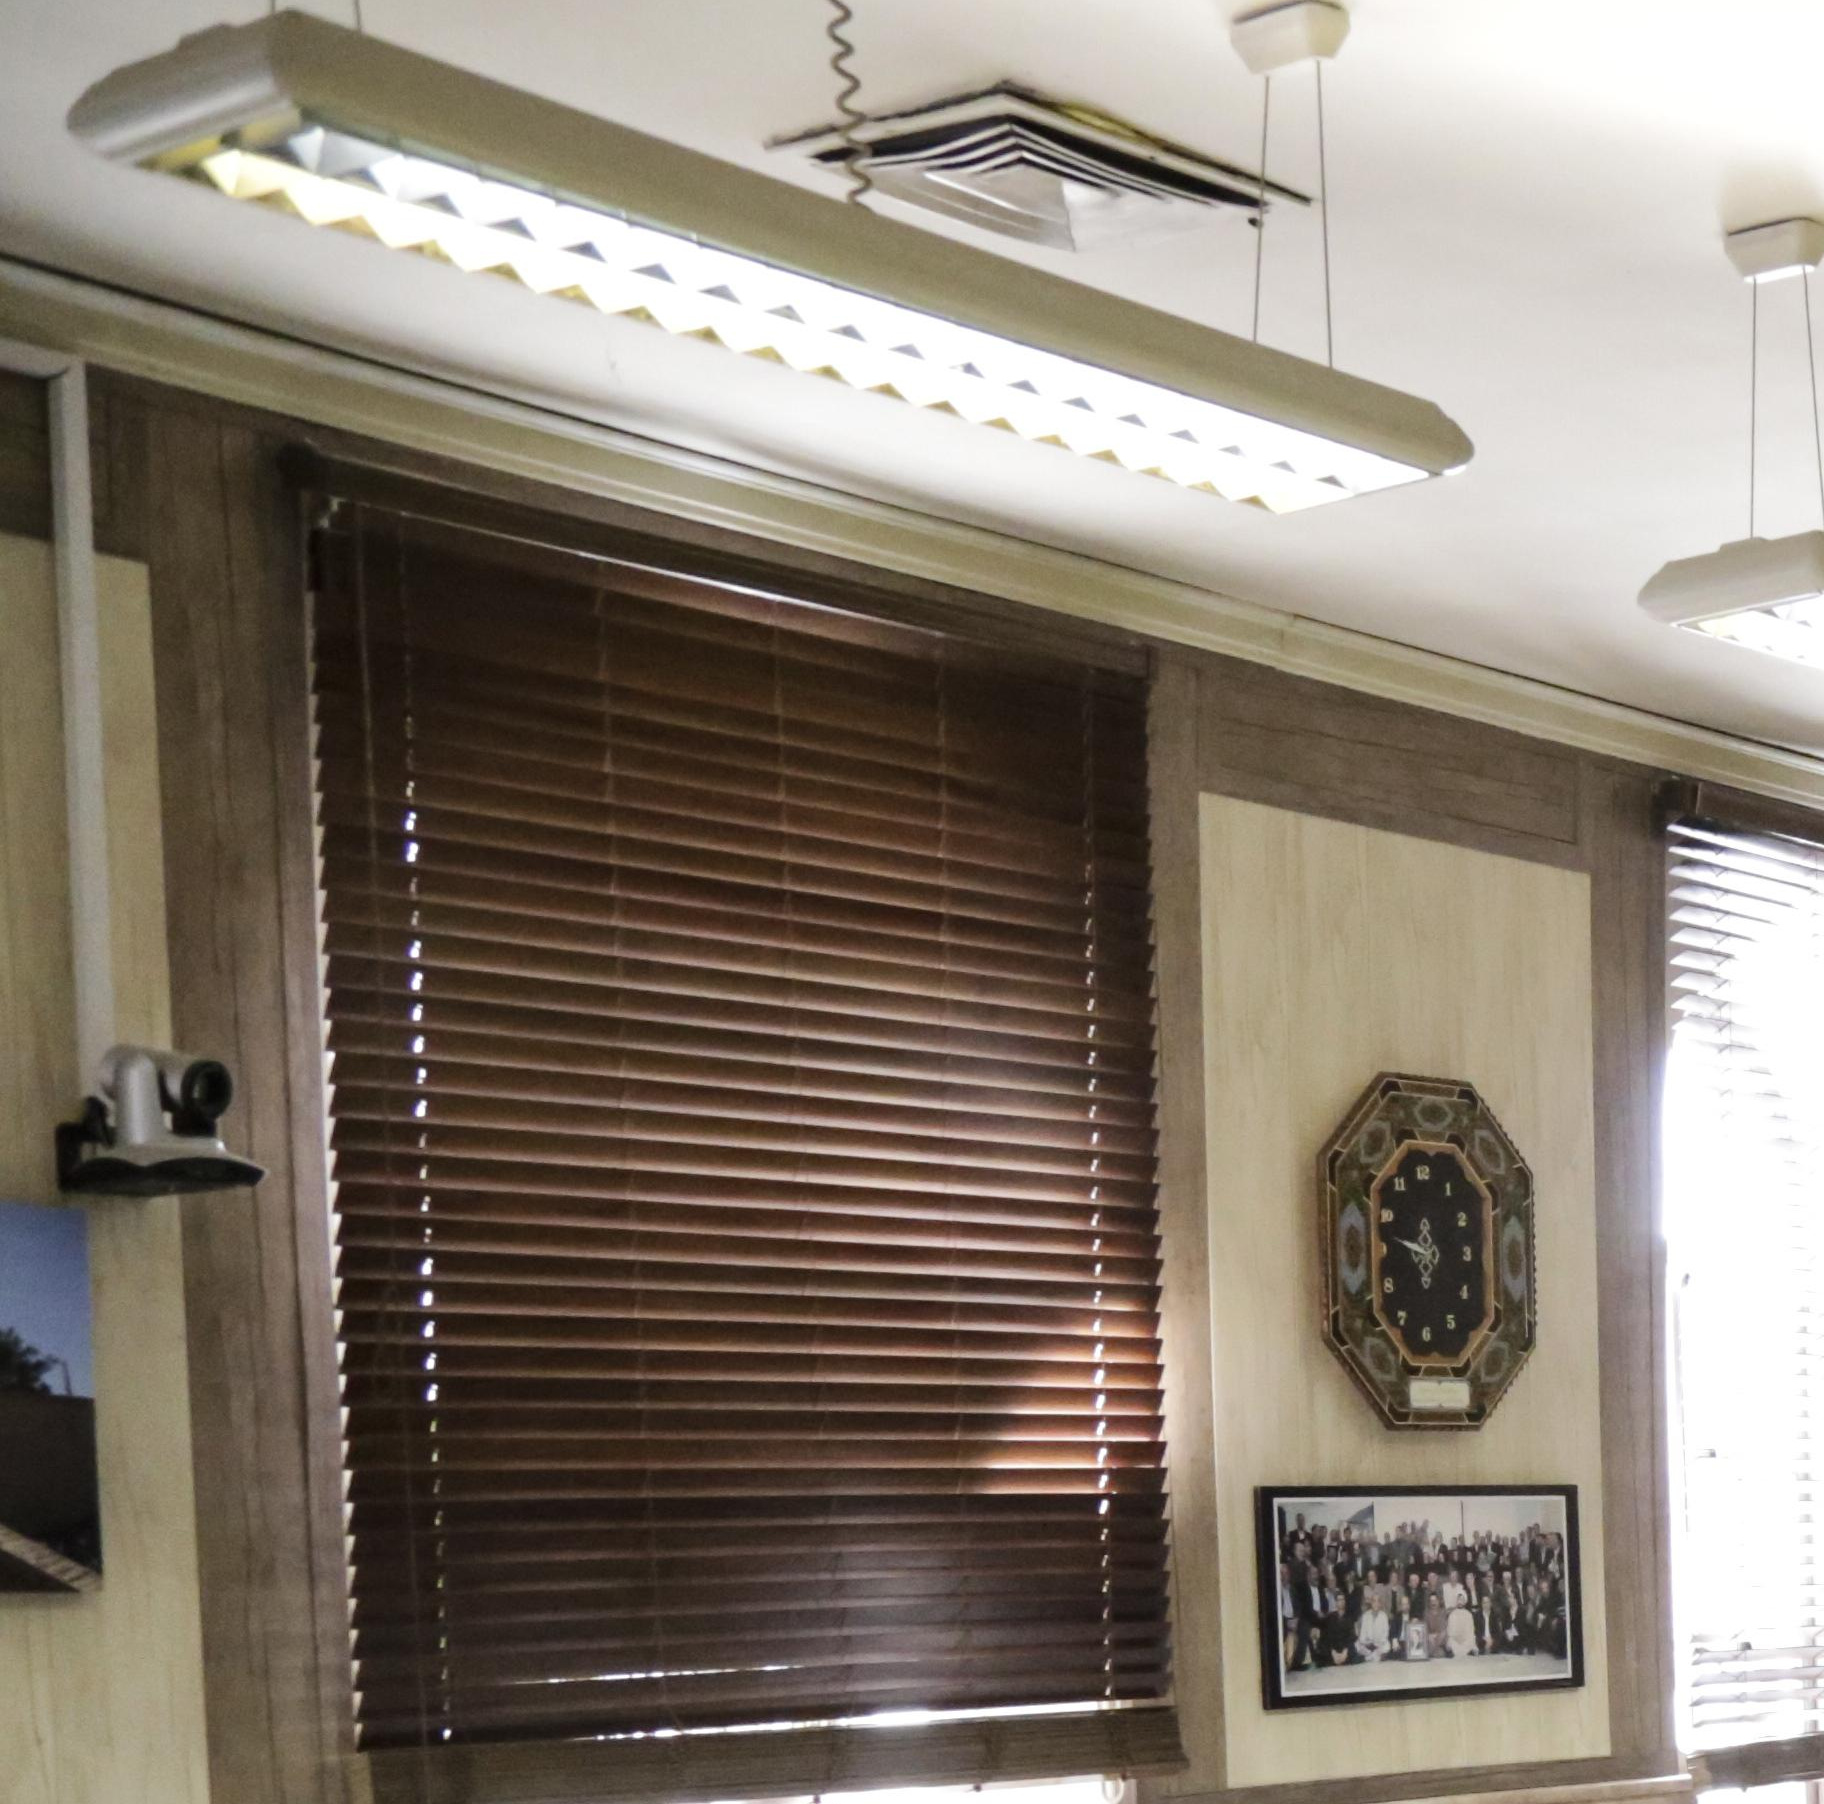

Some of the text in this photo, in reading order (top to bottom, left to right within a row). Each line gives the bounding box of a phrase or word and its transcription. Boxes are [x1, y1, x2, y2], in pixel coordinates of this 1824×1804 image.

[1416, 1165, 1430, 1181] 12
[1394, 1176, 1406, 1191] 11
[1445, 1182, 1452, 1196] 1
[1381, 1208, 1394, 1223] 10
[1457, 1212, 1467, 1227] 2
[1462, 1246, 1472, 1262] 3
[1383, 1277, 1394, 1293] 8
[1459, 1285, 1469, 1300] 4
[1397, 1310, 1407, 1326] 7
[1447, 1314, 1456, 1330] 5
[1421, 1326, 1431, 1342] 6
